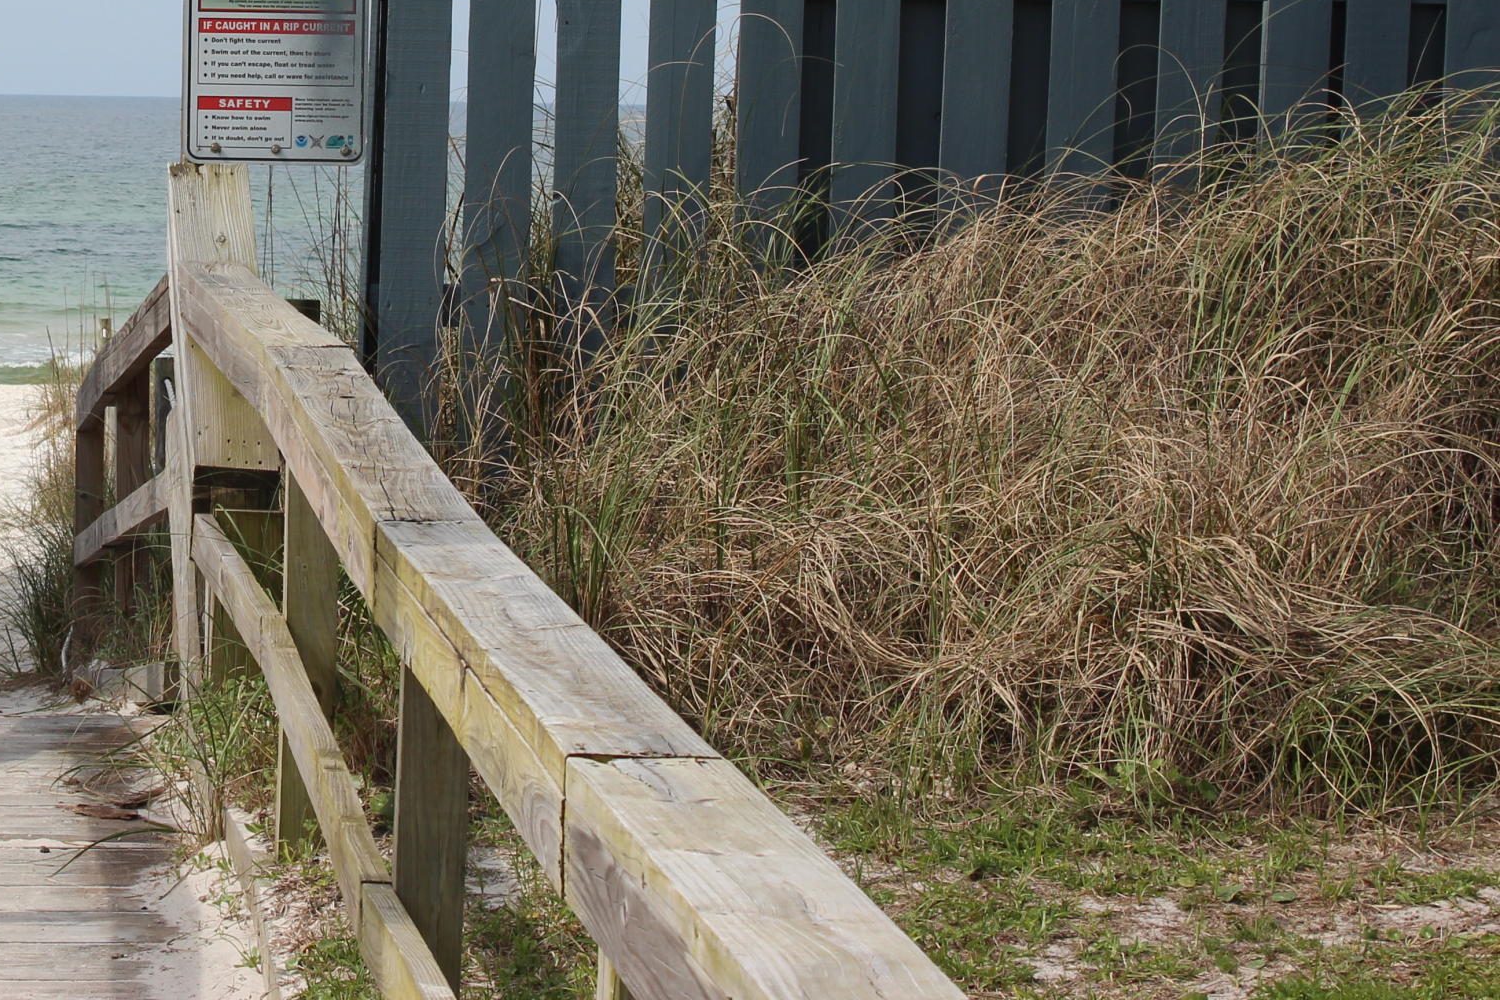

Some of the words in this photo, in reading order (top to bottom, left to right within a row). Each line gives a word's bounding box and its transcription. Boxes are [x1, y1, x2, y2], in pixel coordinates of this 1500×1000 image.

[203, 21, 213, 30] IF
[215, 21, 257, 30] CAUGHT
[260, 22, 270, 30] IN
[273, 22, 280, 31] A
[283, 22, 300, 31] RIP
[302, 23, 350, 32] CURRENT
[219, 99, 270, 109] SAFETY
